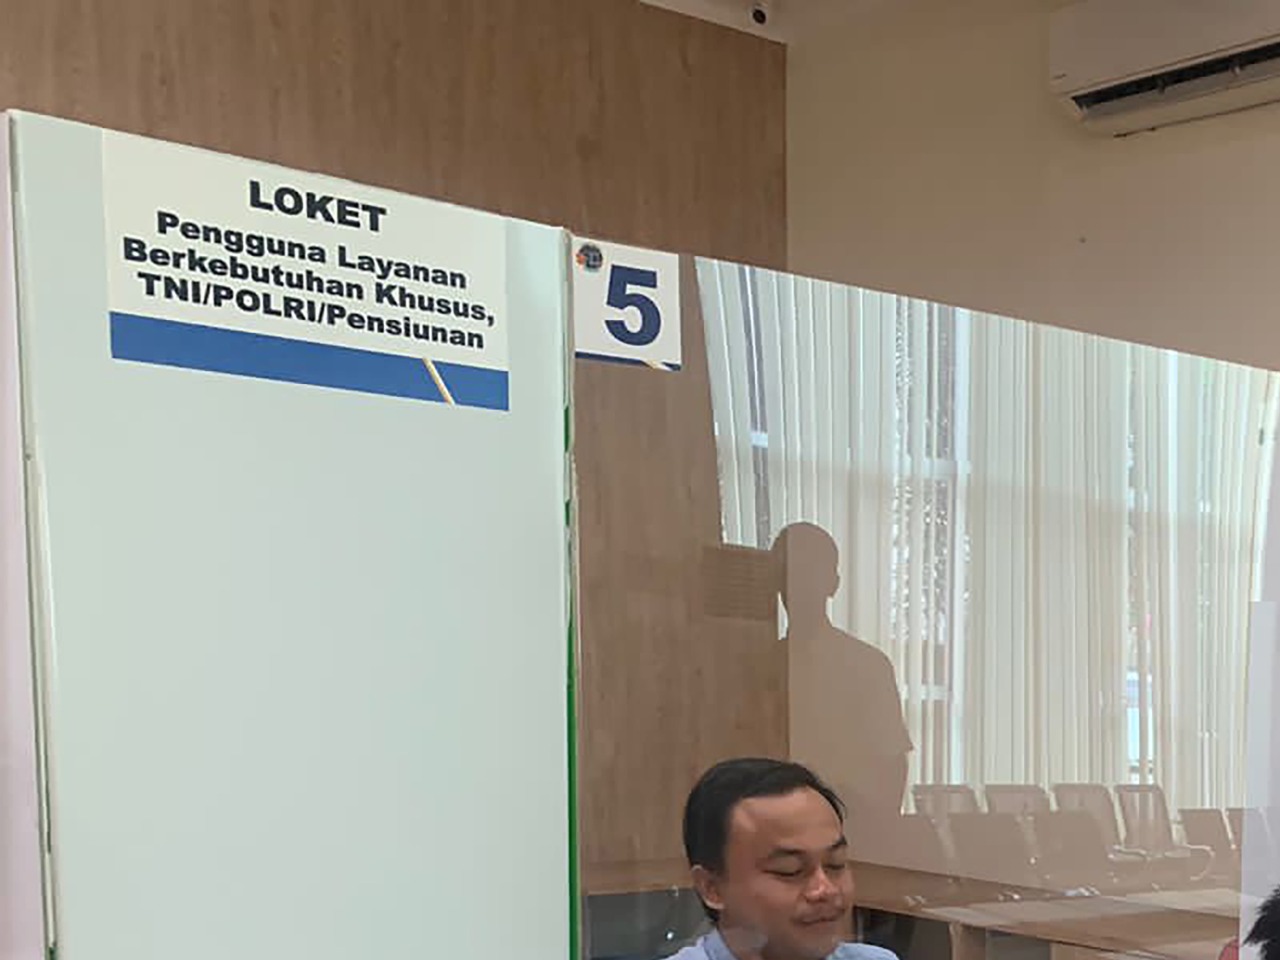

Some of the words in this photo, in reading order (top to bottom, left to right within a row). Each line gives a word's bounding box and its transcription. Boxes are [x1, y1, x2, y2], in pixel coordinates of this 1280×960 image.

[249, 180, 386, 232] LOKET
[122, 237, 364, 300] Berkebutuhan
[375, 281, 495, 326] Khusus,
[157, 211, 327, 263] Pengguna
[338, 246, 467, 290] Layanan
[137, 270, 485, 349] TNI/POLRI/Pensiunan
[604, 264, 662, 346] 5
